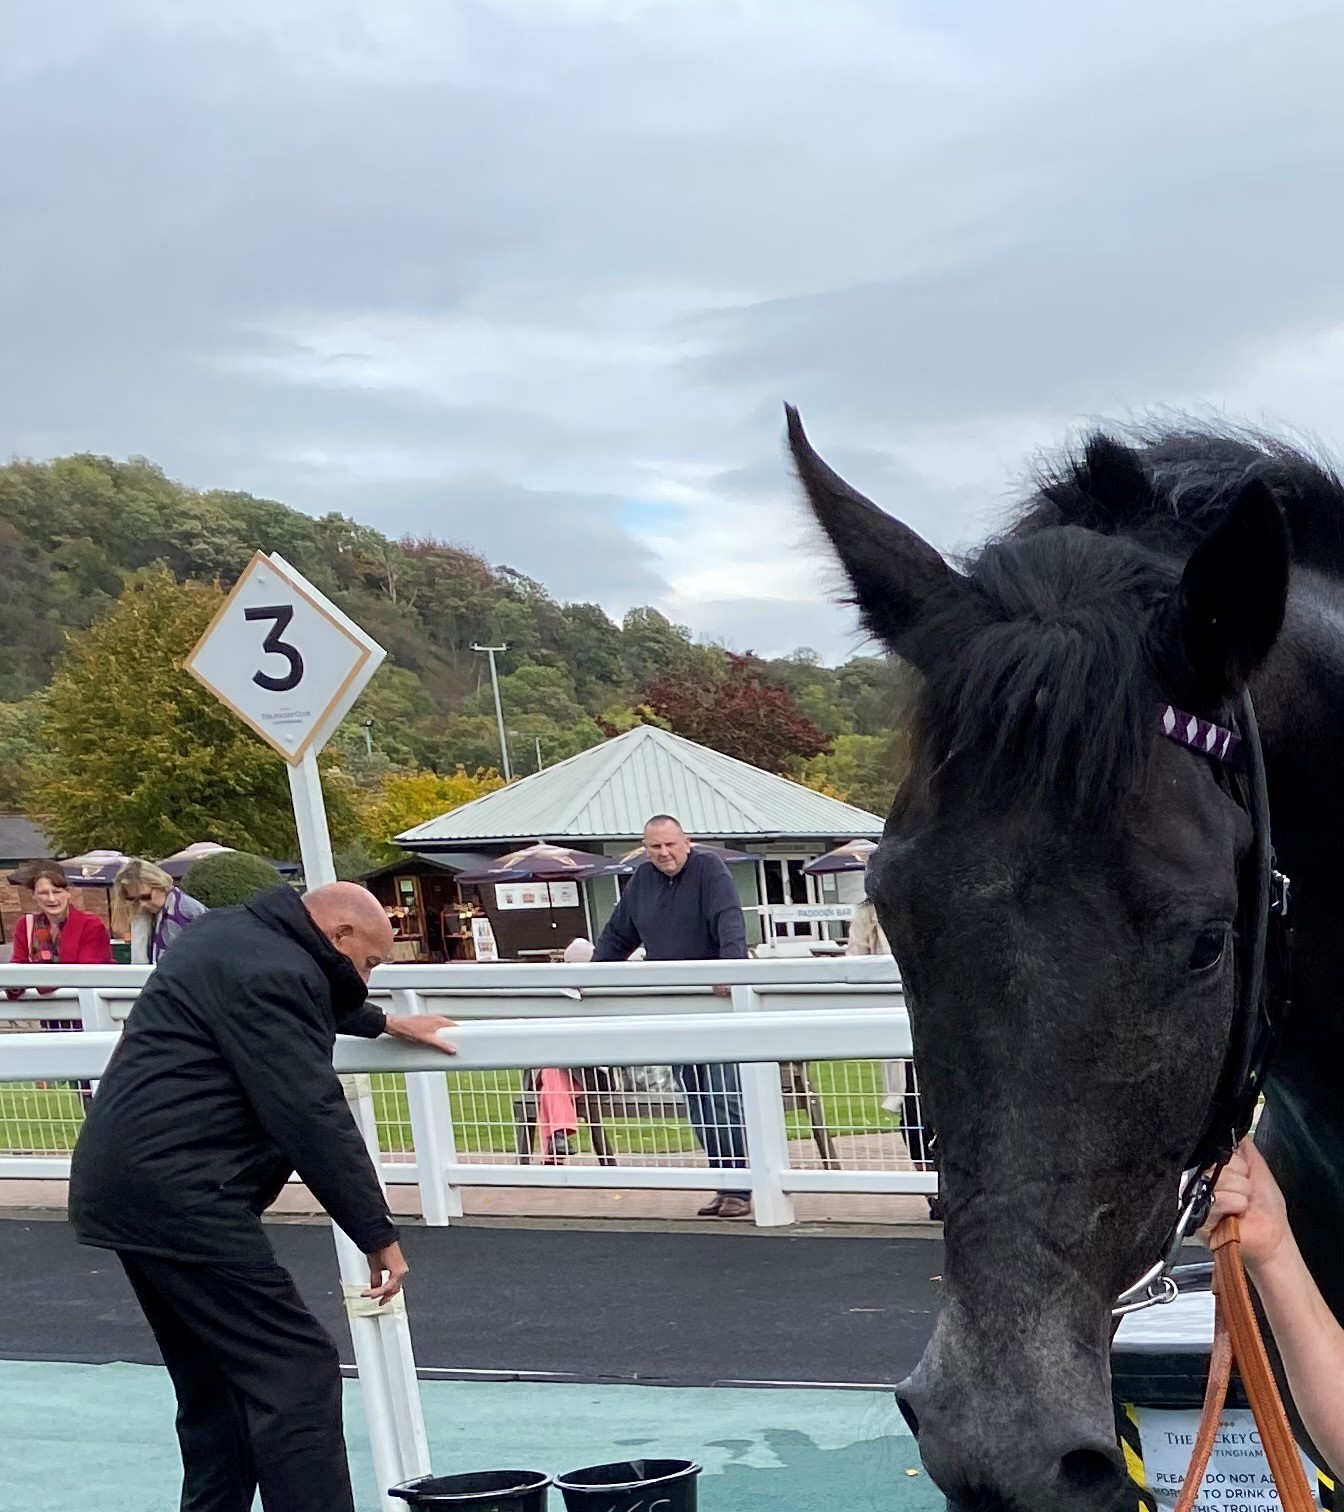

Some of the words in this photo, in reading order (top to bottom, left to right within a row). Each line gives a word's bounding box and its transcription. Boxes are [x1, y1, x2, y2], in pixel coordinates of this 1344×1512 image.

[243, 604, 304, 692] 3
[1163, 1431, 1194, 1445] THE
[1214, 1432, 1247, 1445] CKEY
[1156, 1472, 1185, 1484] PLEA
[1205, 1473, 1226, 1484] DO
[1229, 1473, 1256, 1484] NOT
[1202, 1488, 1222, 1499] TO
[1225, 1488, 1266, 1499] DRINK
